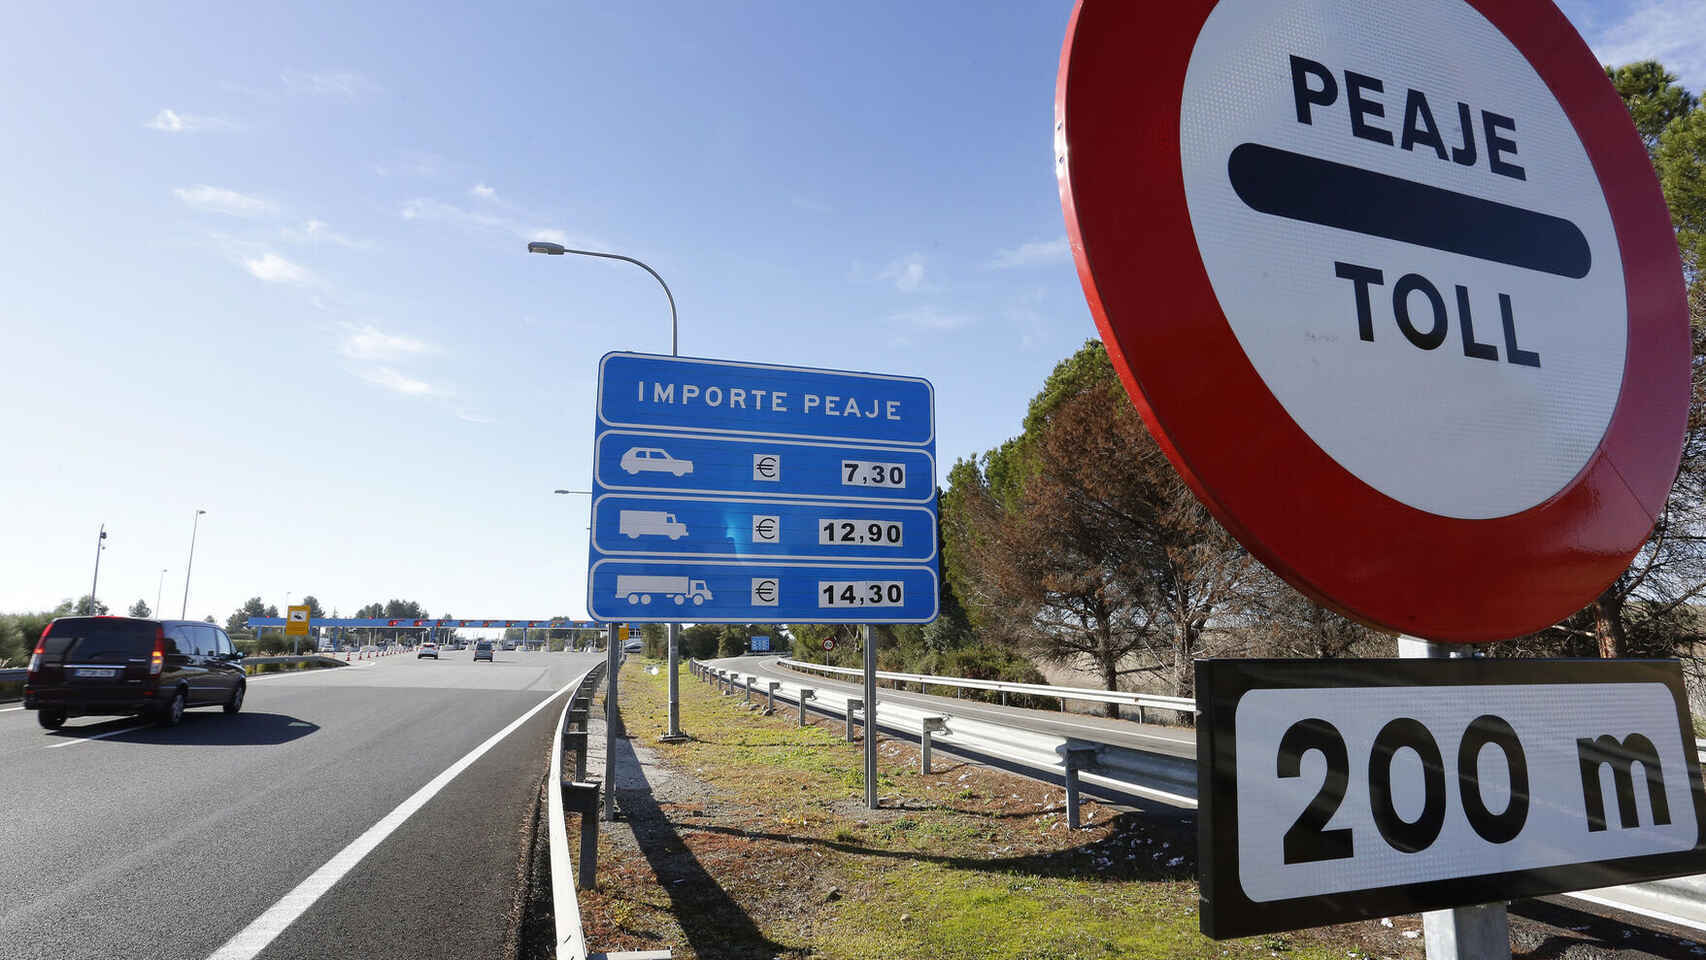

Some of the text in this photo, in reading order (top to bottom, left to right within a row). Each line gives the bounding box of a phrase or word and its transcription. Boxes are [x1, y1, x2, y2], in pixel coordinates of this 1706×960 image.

[1289, 54, 1527, 181] PEAJE
[1334, 261, 1541, 368] TOLL
[638, 381, 902, 421] IMPORTE PEAJE
[756, 456, 904, 485] € 7,30
[756, 518, 902, 544] € 12,90
[755, 580, 902, 606] € 14,30
[1276, 714, 1671, 865] 200 m
